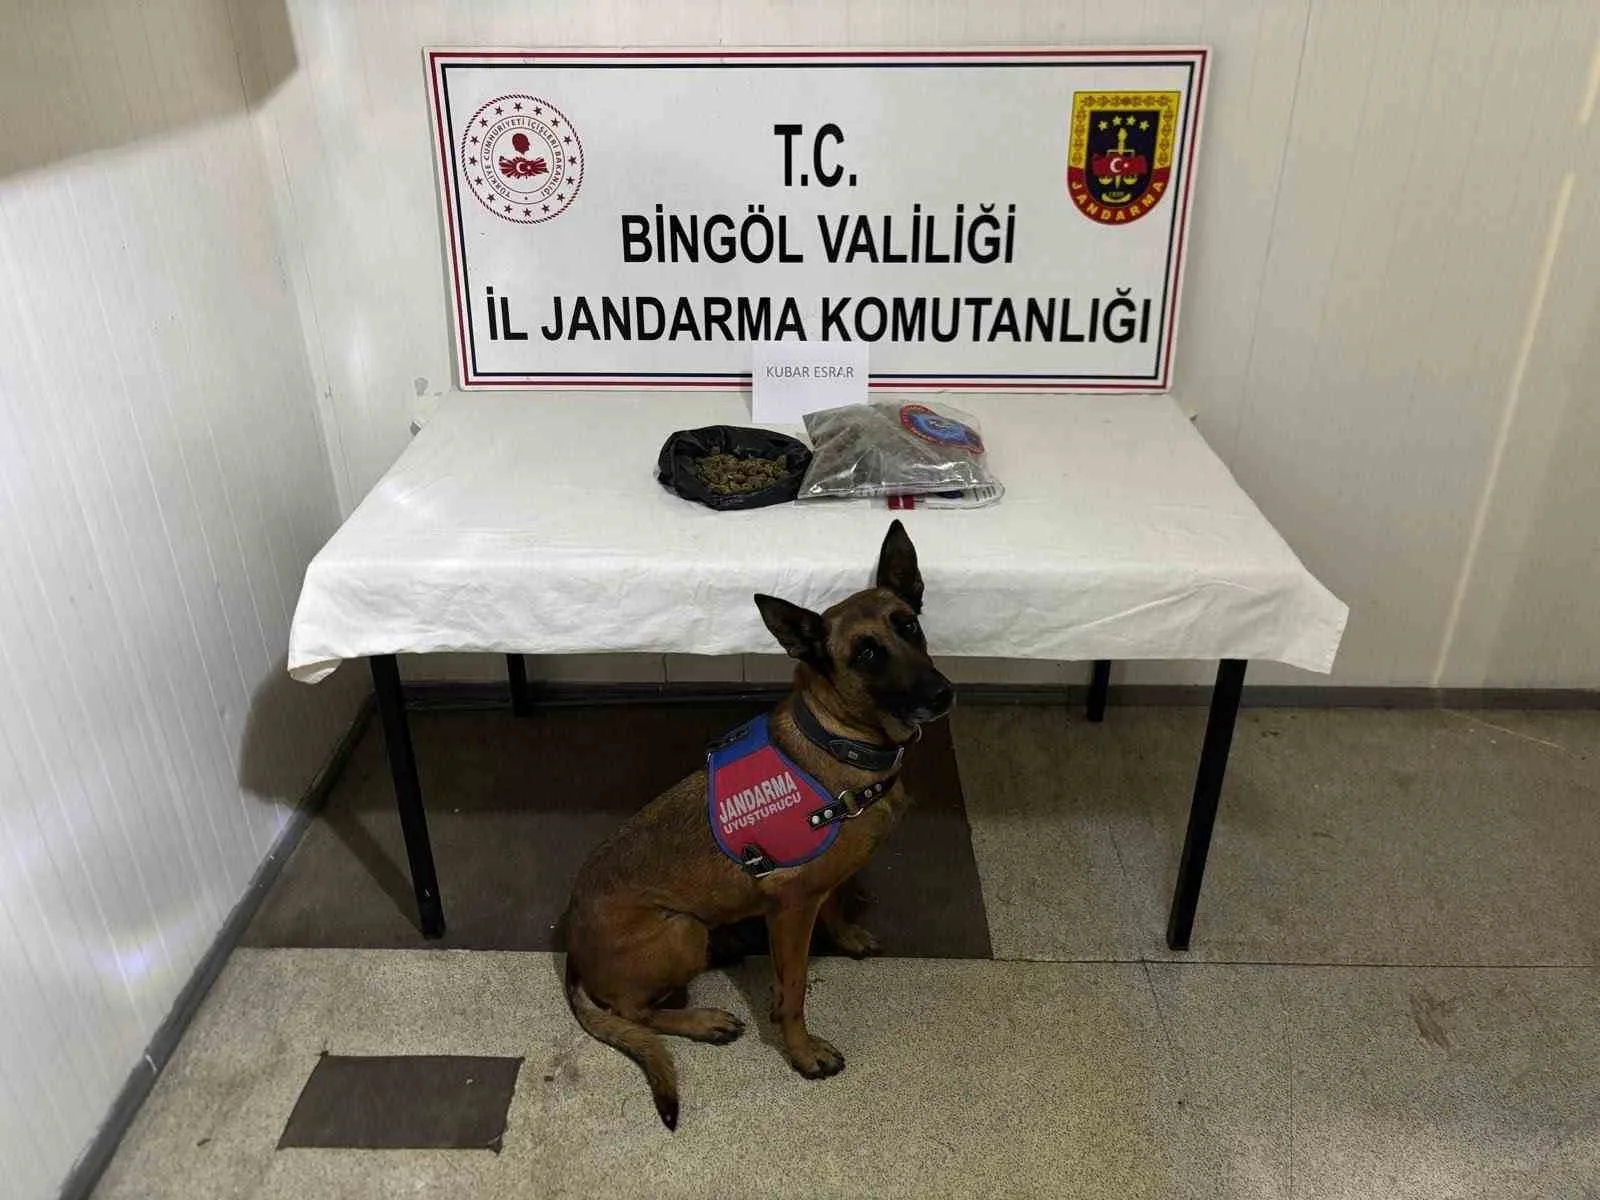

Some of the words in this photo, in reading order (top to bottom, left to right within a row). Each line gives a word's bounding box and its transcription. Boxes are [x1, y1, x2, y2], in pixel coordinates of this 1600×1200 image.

[484, 118, 524, 160] CUMHURİYETİ
[774, 123, 857, 188] T.C.
[1072, 182, 1164, 220] JANDARMA
[622, 203, 804, 263] BİNGÖL
[817, 203, 1016, 264] VALİLİĞİ
[486, 287, 529, 340] İL
[541, 296, 808, 342] JANDARMA
[822, 287, 1152, 343] KOMUTANLIĞI
[766, 366, 810, 378] KUBAR
[814, 366, 854, 378] ESRAR
[719, 773, 798, 823] JANDARMA
[724, 792, 802, 834] UYUŞTURUCU
